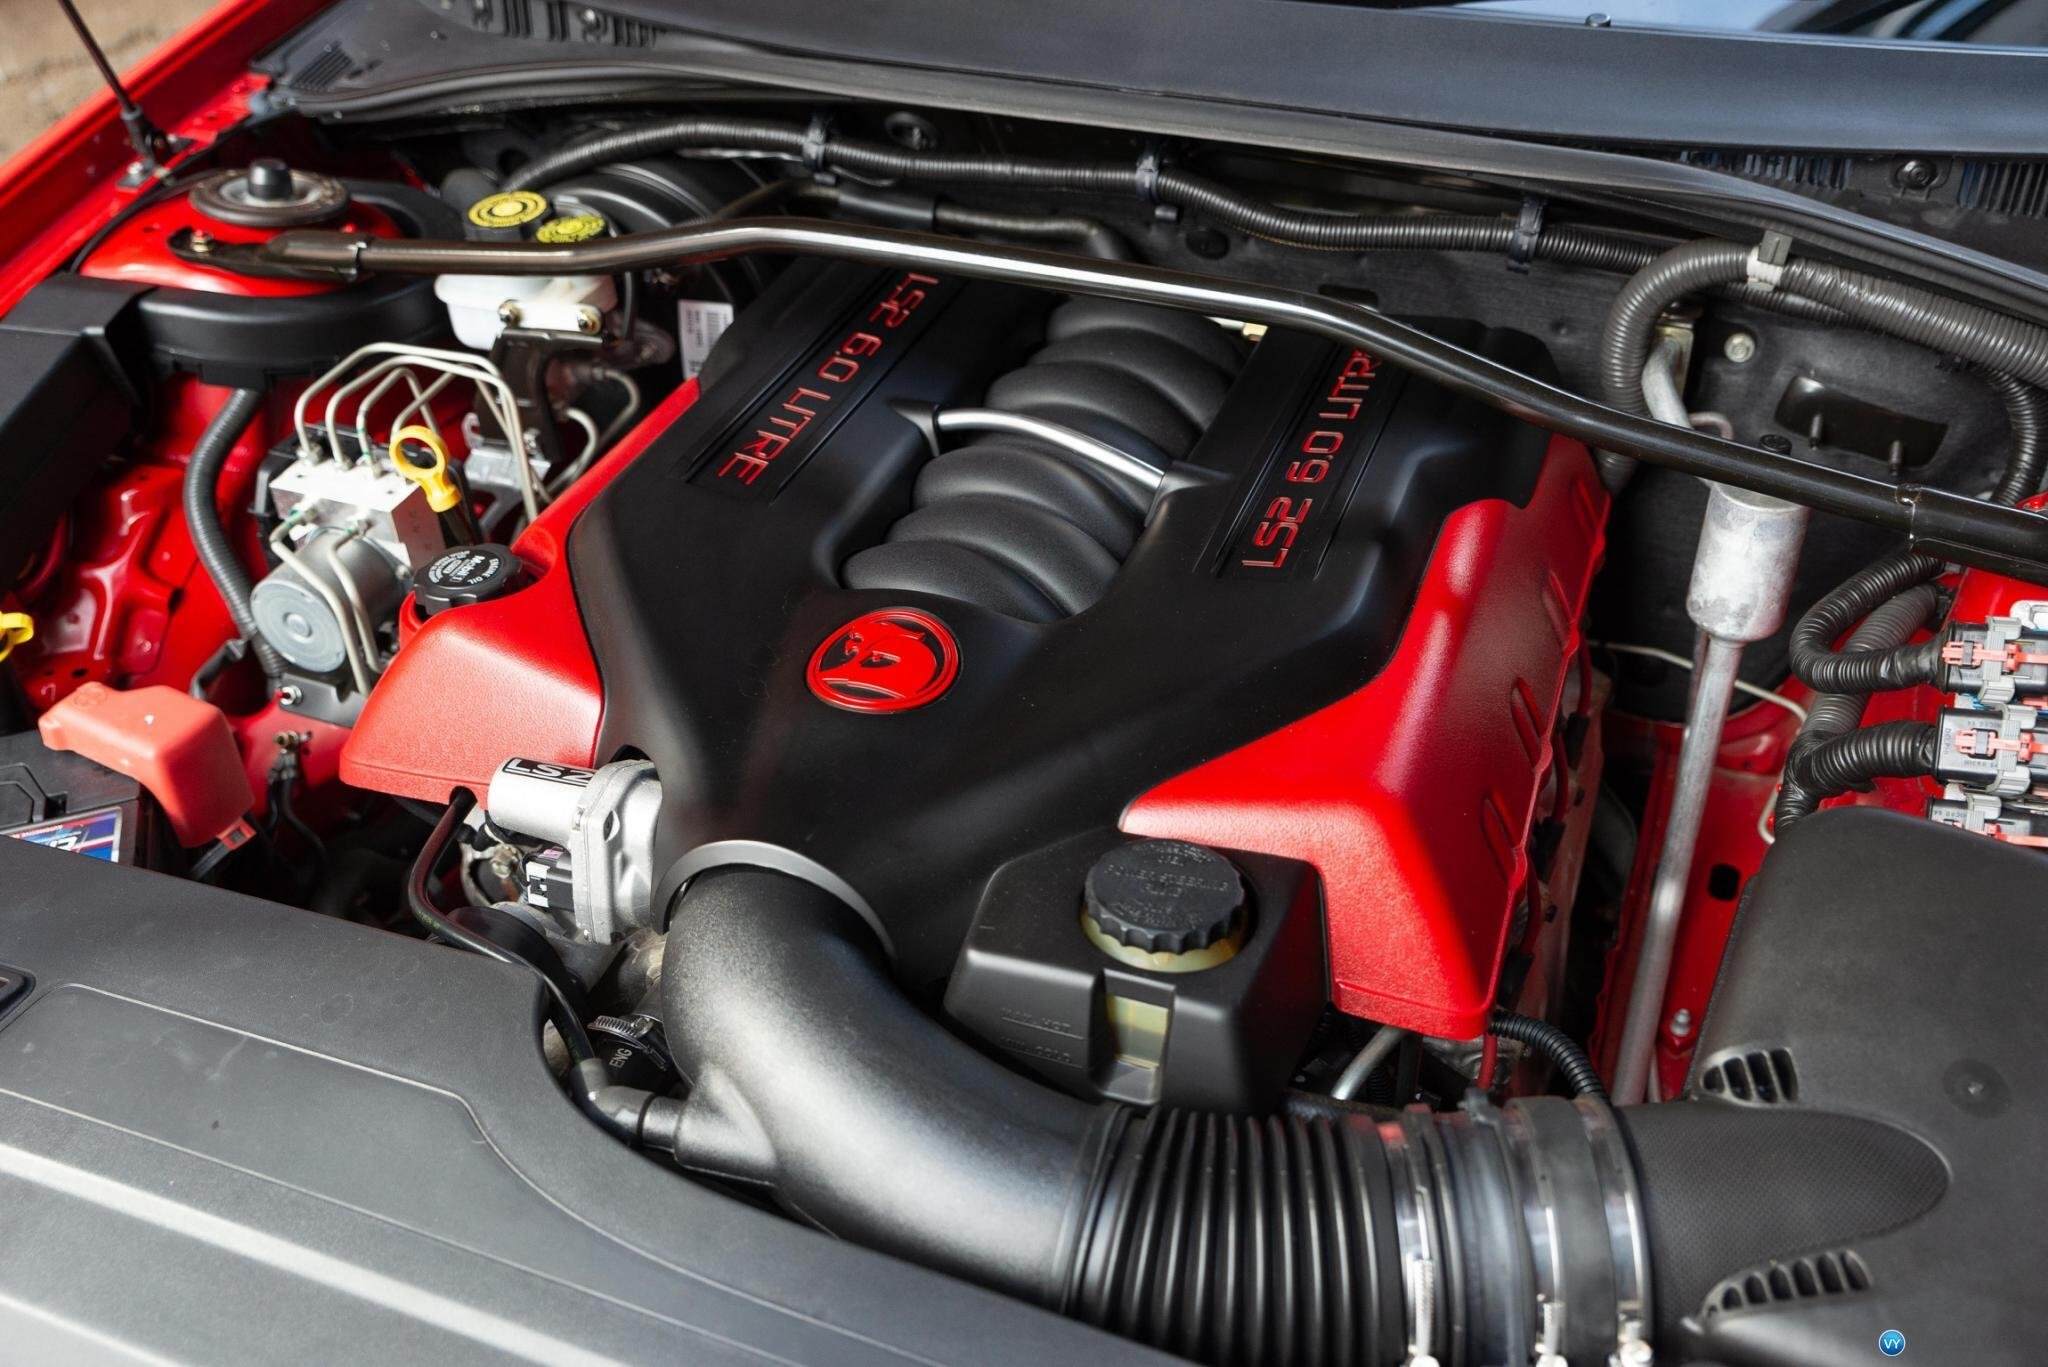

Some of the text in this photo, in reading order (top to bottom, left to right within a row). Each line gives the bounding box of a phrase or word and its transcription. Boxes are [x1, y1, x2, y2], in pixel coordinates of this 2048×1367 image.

[717, 272, 940, 486] LS2 6.0 LITRE
[1241, 349, 1381, 569] LS2 6.0 LITR
[467, 576, 484, 585] OIL
[505, 757, 594, 785] LS2
[608, 1047, 633, 1069] ENG
